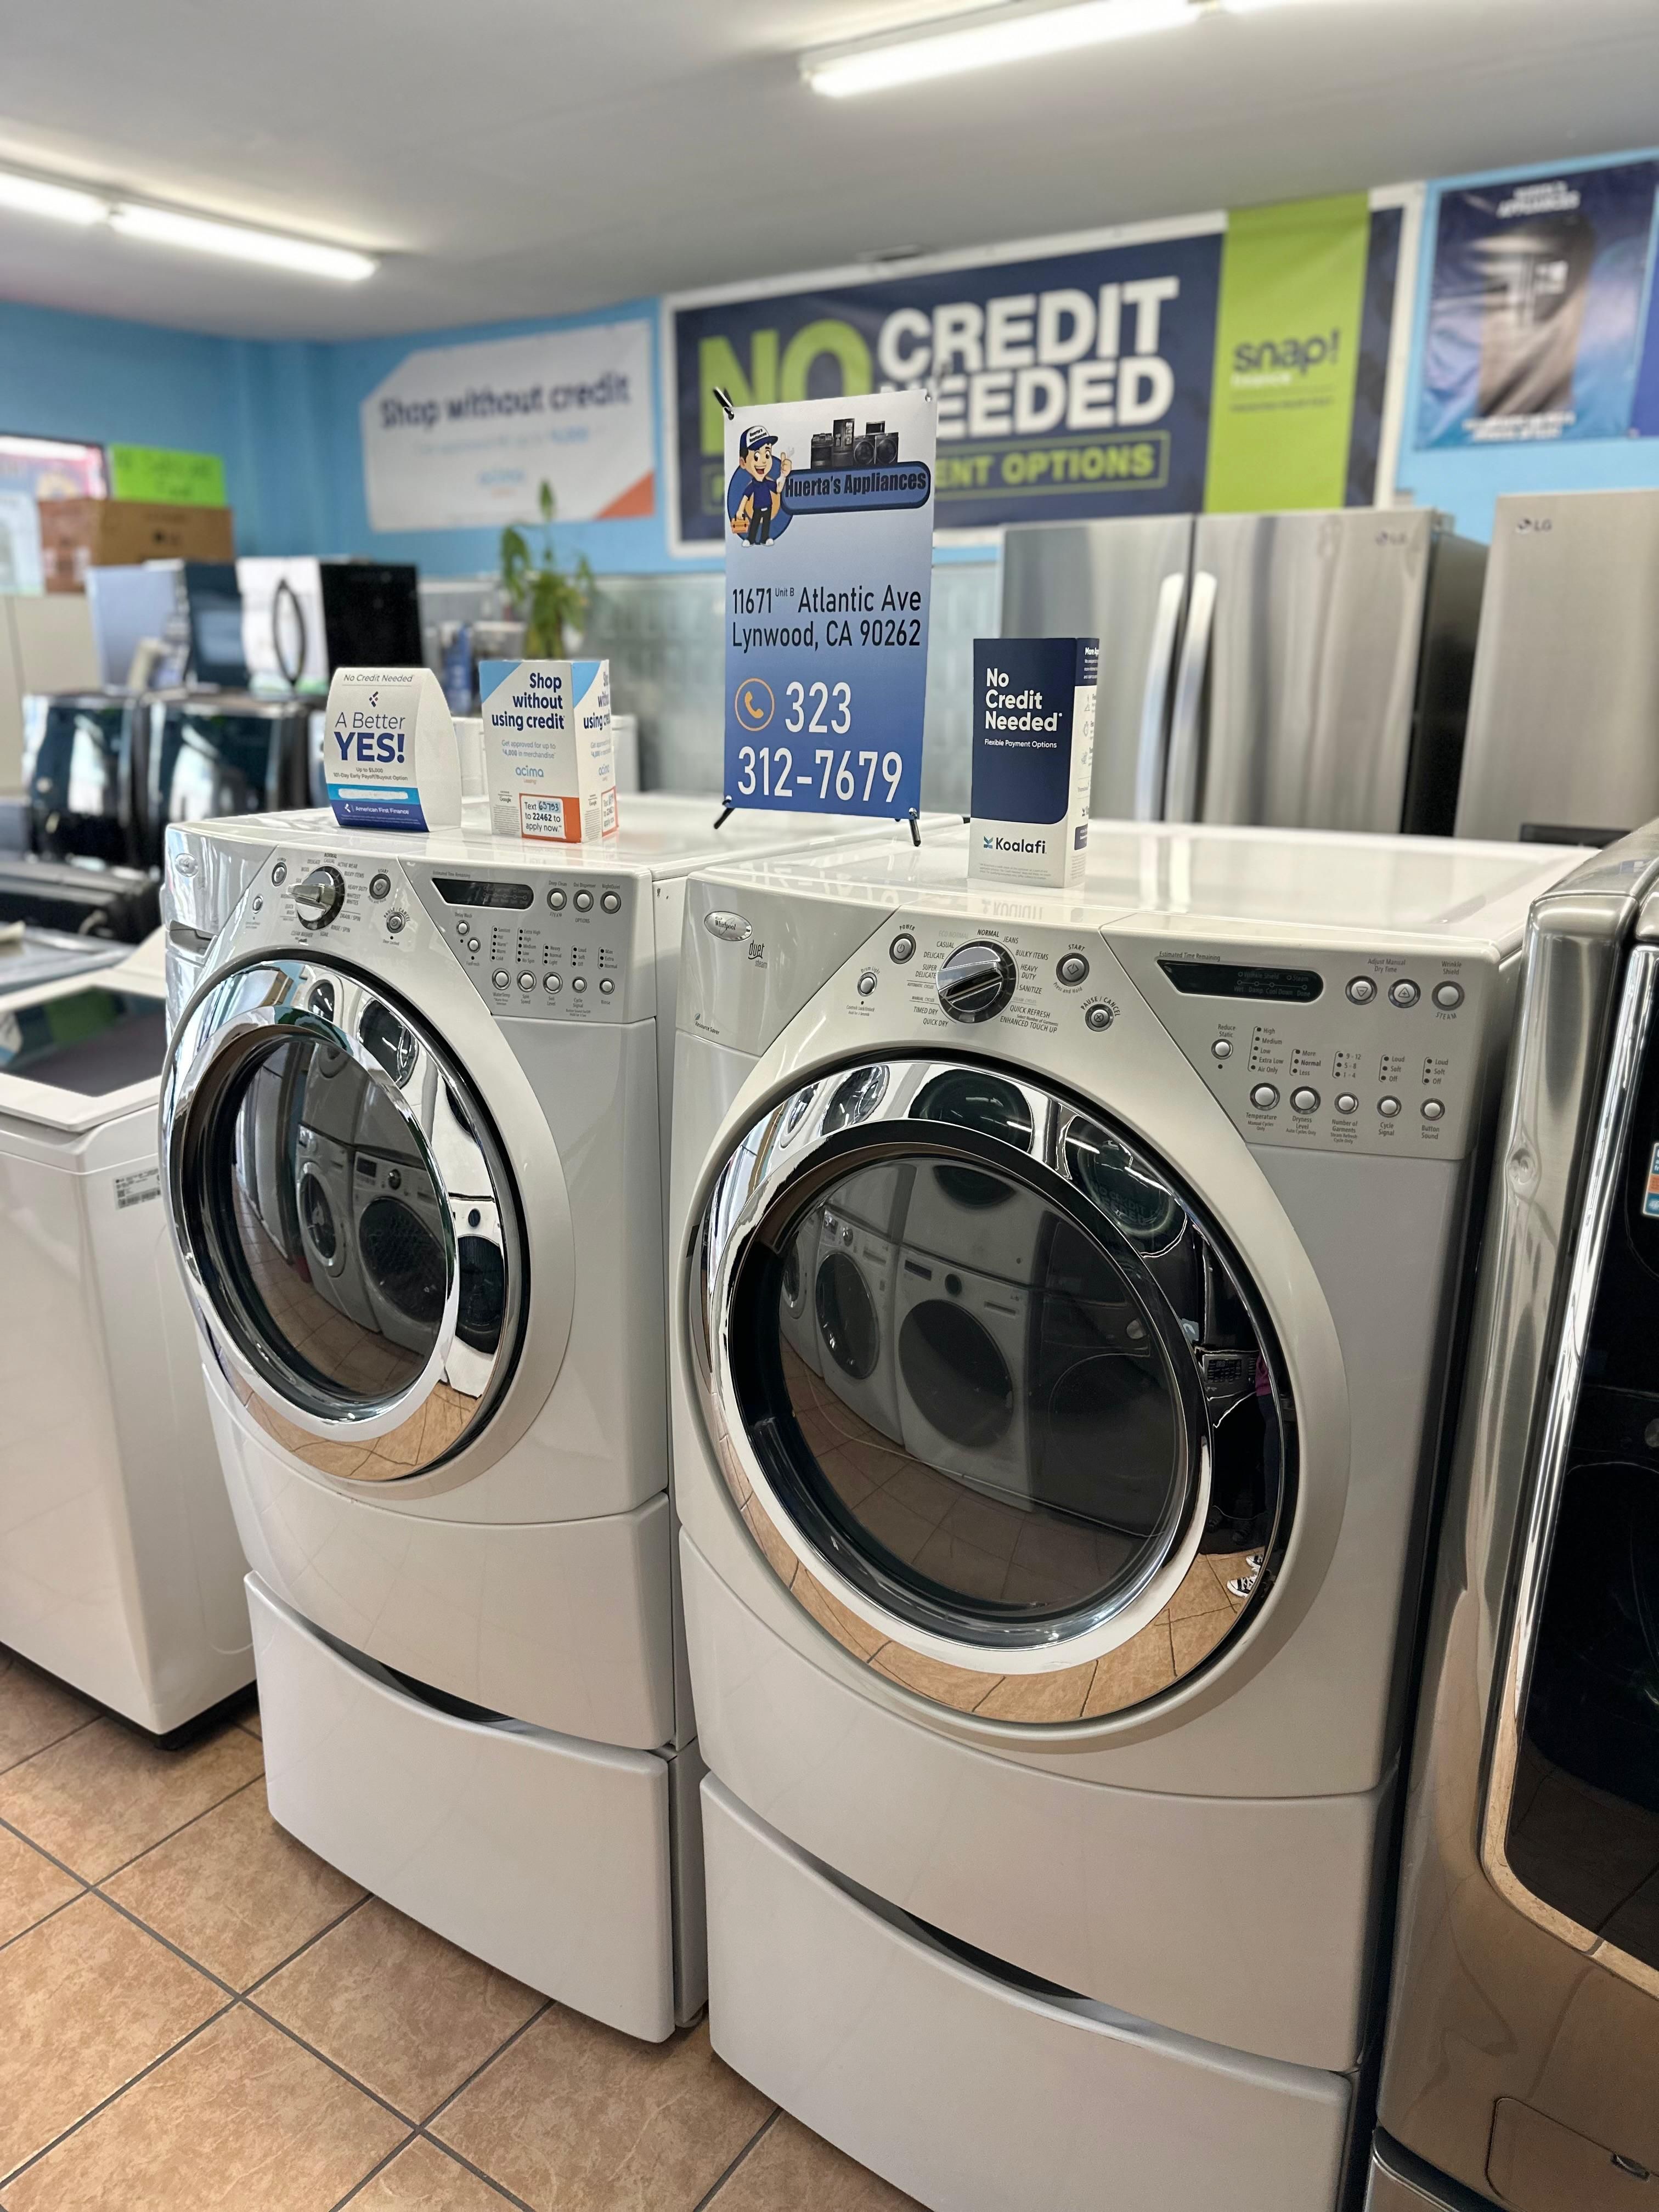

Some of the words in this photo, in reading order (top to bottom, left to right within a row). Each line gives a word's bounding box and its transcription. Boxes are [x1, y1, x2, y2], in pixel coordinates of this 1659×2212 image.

[878, 276, 1180, 382] CREDIT
[1232, 328, 1340, 375] snap!
[698, 318, 873, 456] NO
[380, 398, 436, 431] Shop
[446, 384, 544, 421] without
[549, 371, 631, 411] credit
[880, 356, 1175, 439] EEDED
[1002, 443, 1155, 485] OPTIONS
[785, 475, 842, 498] Huerta's
[844, 471, 927, 495] Appliances
[732, 588, 772, 614] 11671
[775, 588, 788, 597] Unit
[789, 588, 795, 597] B
[797, 585, 874, 613] Atlantic
[881, 584, 922, 612] Ave
[732, 620, 819, 654] Lynwood,
[826, 620, 853, 647] CA
[860, 619, 921, 647] 90262
[357, 674, 380, 682] Credit
[381, 674, 413, 682] Needed
[529, 673, 562, 693] Shop
[985, 667, 1009, 689] No
[512, 692, 563, 709] without
[984, 689, 1042, 710] Credit
[785, 681, 851, 734] 323
[335, 712, 347, 728] A
[352, 712, 406, 730] Better
[492, 711, 523, 731] using
[526, 713, 565, 730] credit
[583, 712, 603, 731] using
[984, 710, 1058, 732] Needed
[334, 731, 405, 764] YES!
[510, 741, 534, 749] approved
[1005, 740, 1031, 748] Payment
[1031, 741, 1057, 749] Options
[515, 764, 545, 778] acima
[737, 746, 903, 803] 312-7679
[524, 802, 537, 811] Text
[532, 812, 552, 822] 22462
[526, 823, 543, 832] apply
[995, 837, 1046, 854] Koalafi
[714, 919, 736, 932] Whirlpool
[977, 929, 1000, 938] NORMAL
[1003, 936, 1019, 944] JEANS
[748, 939, 765, 958] duet
[936, 940, 955, 949] CASUAL
[1068, 944, 1086, 952] START
[923, 951, 945, 960] DELICATE
[1015, 949, 1033, 958] BULKY
[1032, 952, 1049, 961] ITEMS
[1196, 953, 1221, 962] Remaining
[754, 960, 768, 969] steam
[1020, 963, 1039, 973] HEAVY
[915, 970, 936, 979] DELICATE
[1021, 972, 1036, 980] DUTY
[1019, 984, 1042, 995] SANITIZE
[913, 1006, 928, 1014] TIMED
[928, 1007, 939, 1015] DRY
[1009, 1005, 1026, 1014] QUICK
[1027, 1008, 1051, 1019] REFRESH
[1080, 996, 1098, 1011] PAUSE
[1103, 996, 1121, 1017] CANCEL
[695, 1021, 710, 1032] Resource
[709, 1025, 720, 1035] Saver
[923, 1018, 937, 1026] QUICK
[938, 1019, 949, 1028] DRY
[1000, 1015, 1029, 1028] ENHANCED
[1029, 1022, 1048, 1032] TOUCH
[1263, 1028, 1276, 1036] High
[1266, 1066, 1278, 1075] Only
[1246, 1111, 1277, 1120] Temperature
[1292, 1115, 1312, 1124] Dryness
[1378, 1128, 1395, 1137] Signal
[1421, 1132, 1439, 1140] Sound
